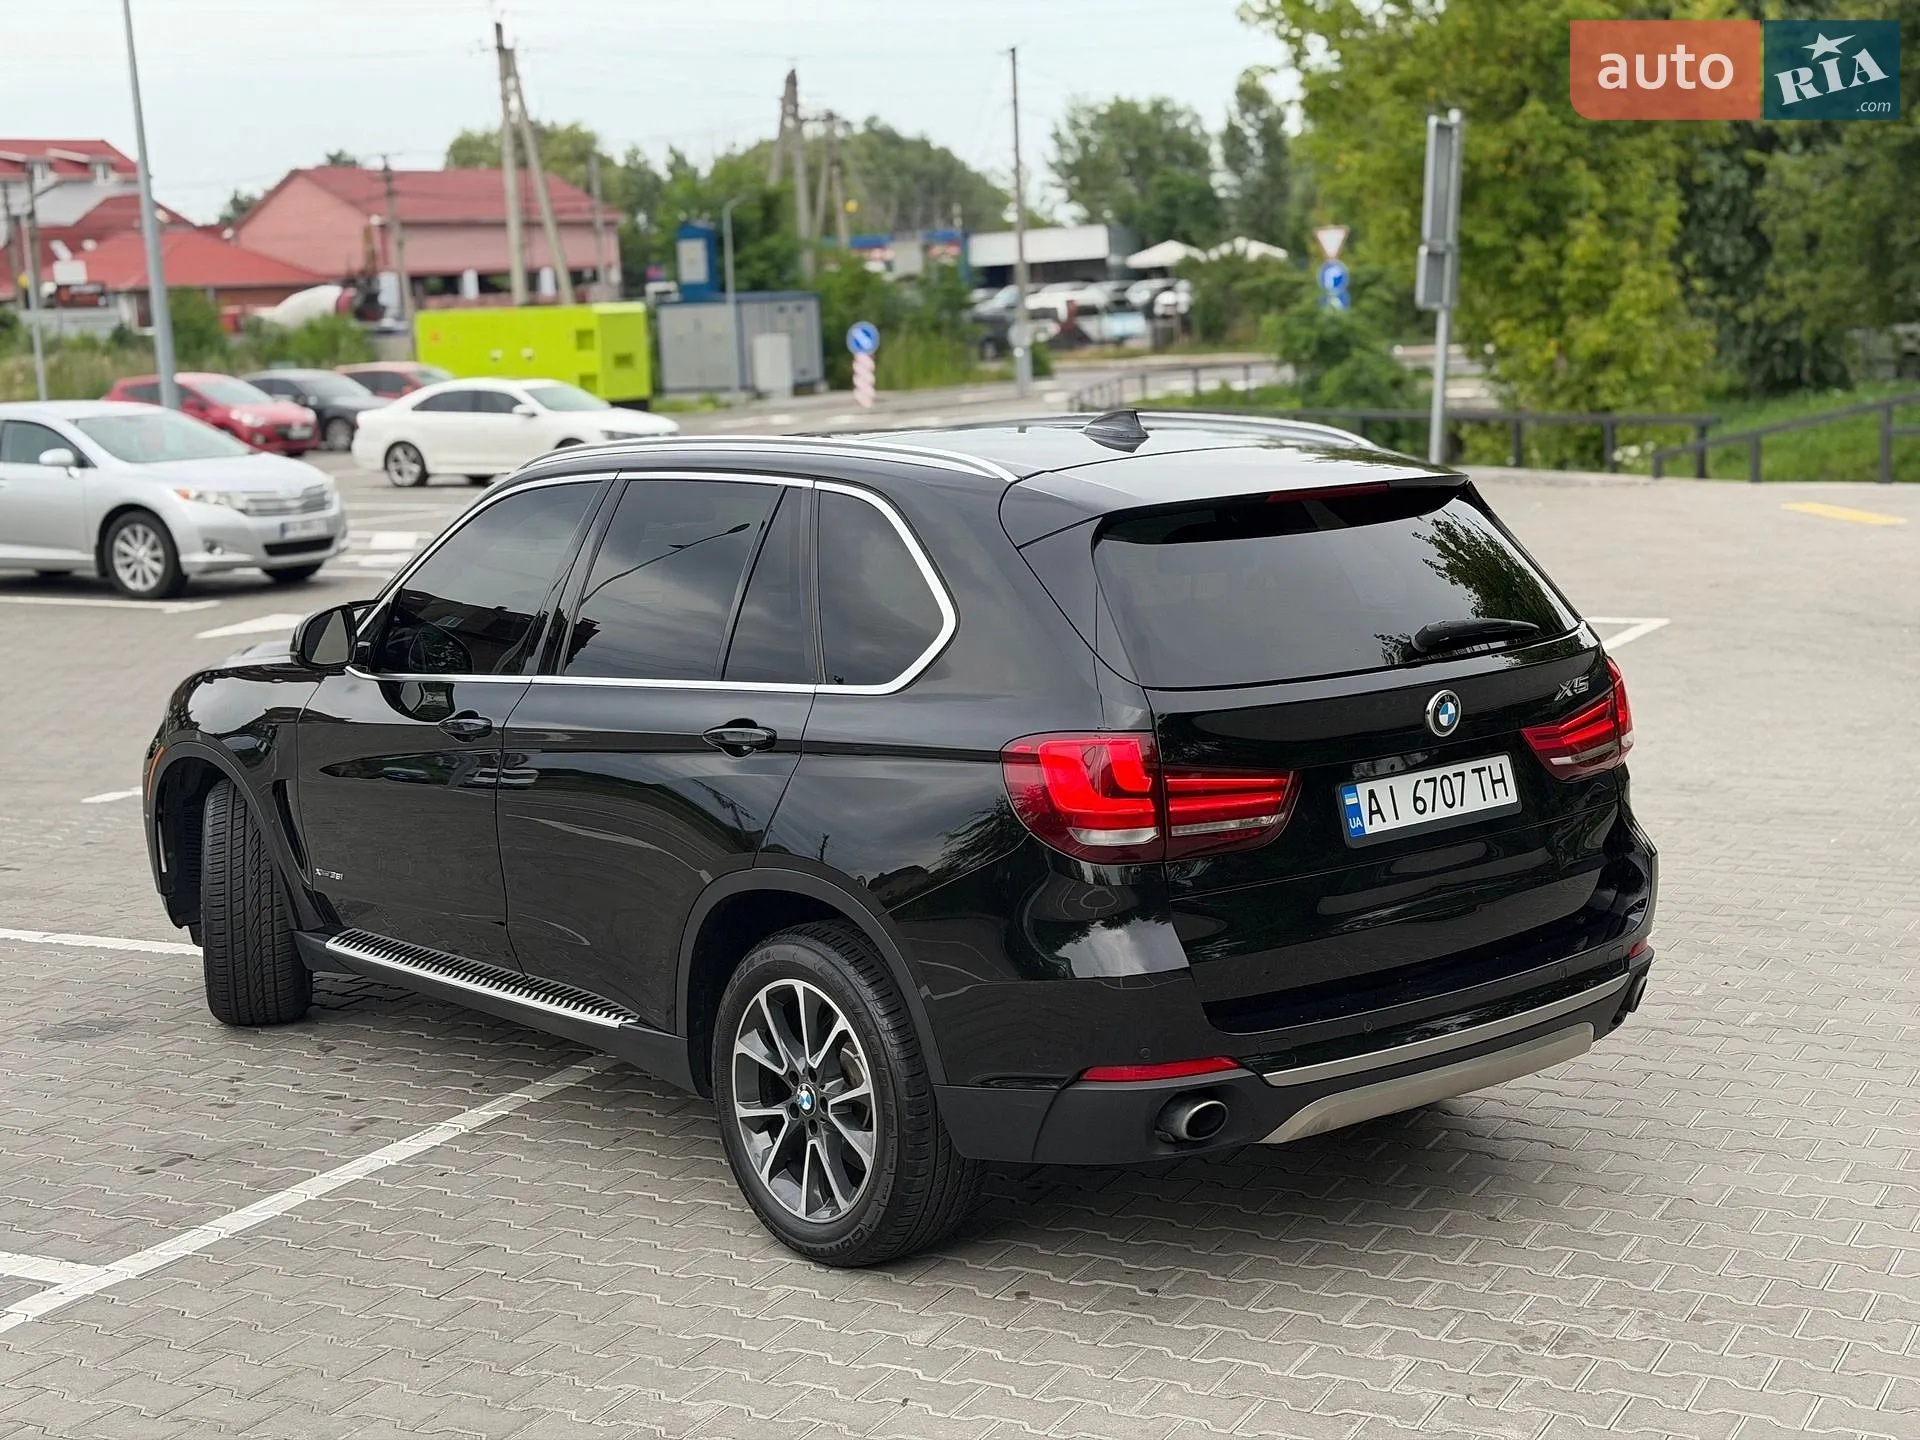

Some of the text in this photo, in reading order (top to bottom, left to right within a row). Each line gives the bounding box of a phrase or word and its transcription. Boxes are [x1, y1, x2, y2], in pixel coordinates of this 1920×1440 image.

[1554, 675, 1589, 701] X5
[1412, 771, 1466, 815] 6707
[1471, 763, 1509, 802] TH
[1350, 818, 1363, 829] UA
